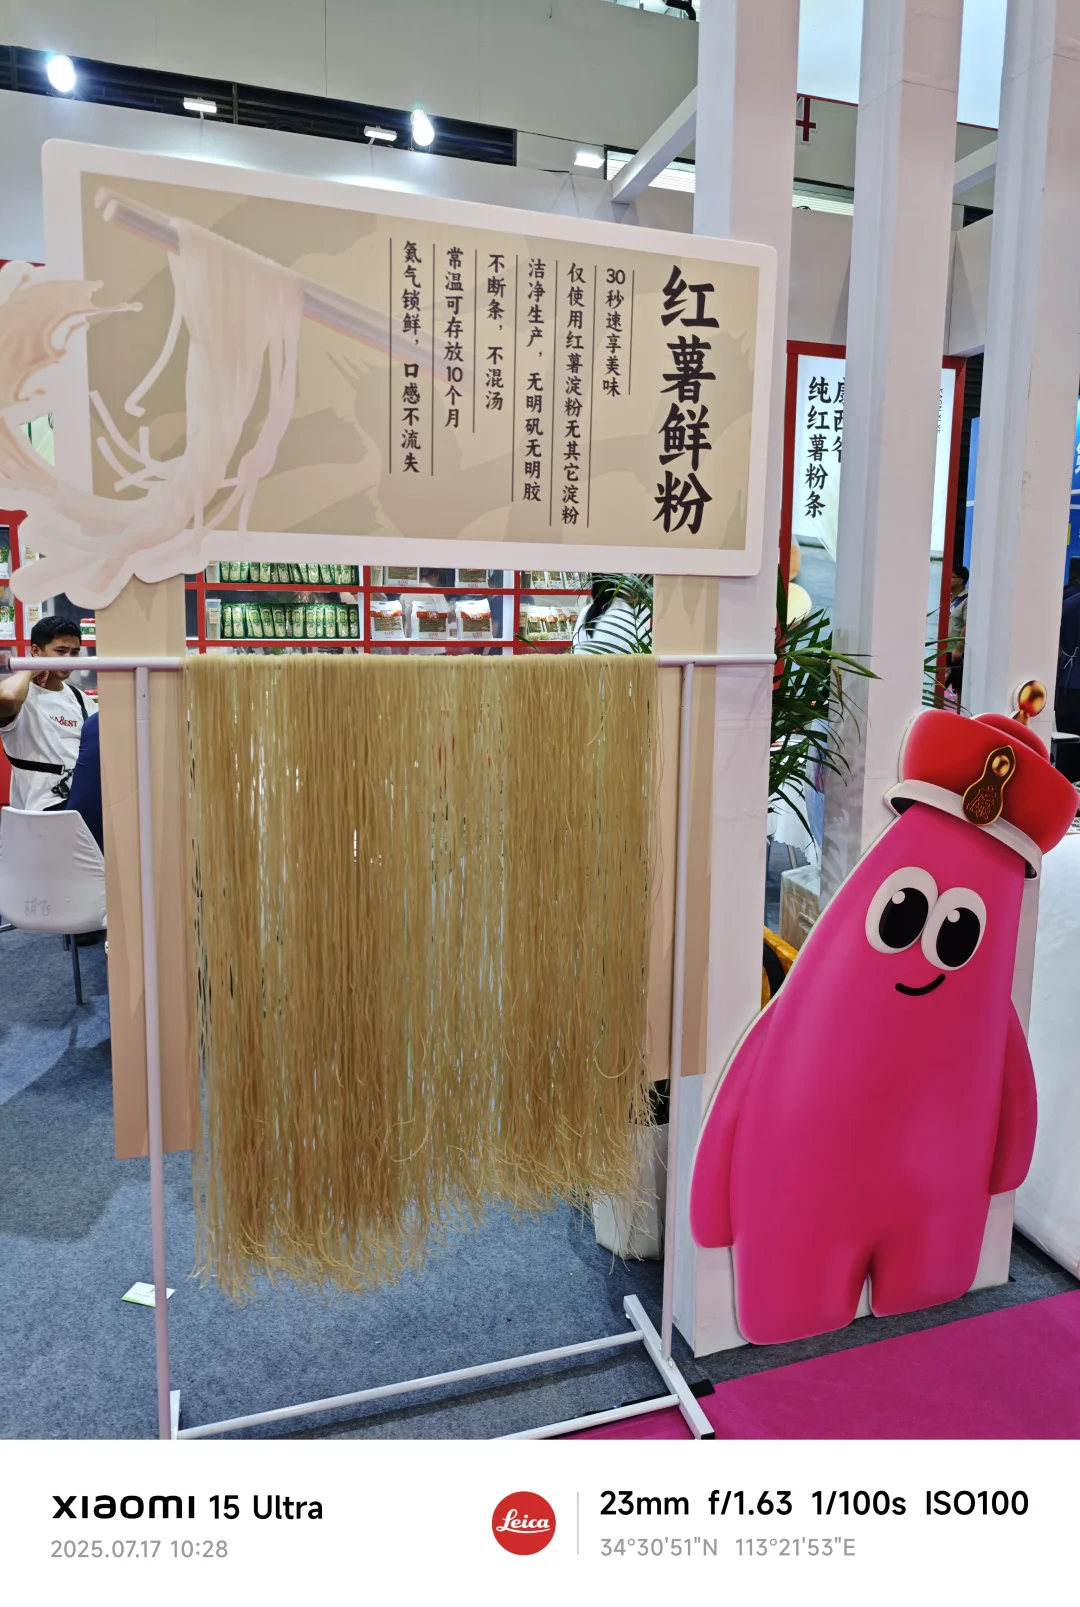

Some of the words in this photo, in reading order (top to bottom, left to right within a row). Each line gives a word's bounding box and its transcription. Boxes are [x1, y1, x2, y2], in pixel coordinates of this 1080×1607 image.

[443, 246, 464, 429] 常温可存放10个月
[561, 262, 587, 525] 仅使用红薯淀粉无其它淀粉
[602, 267, 626, 398] 30秒速享美味
[653, 265, 719, 534] 红薯鲜粉
[803, 376, 832, 519] 纯红薯粉条
